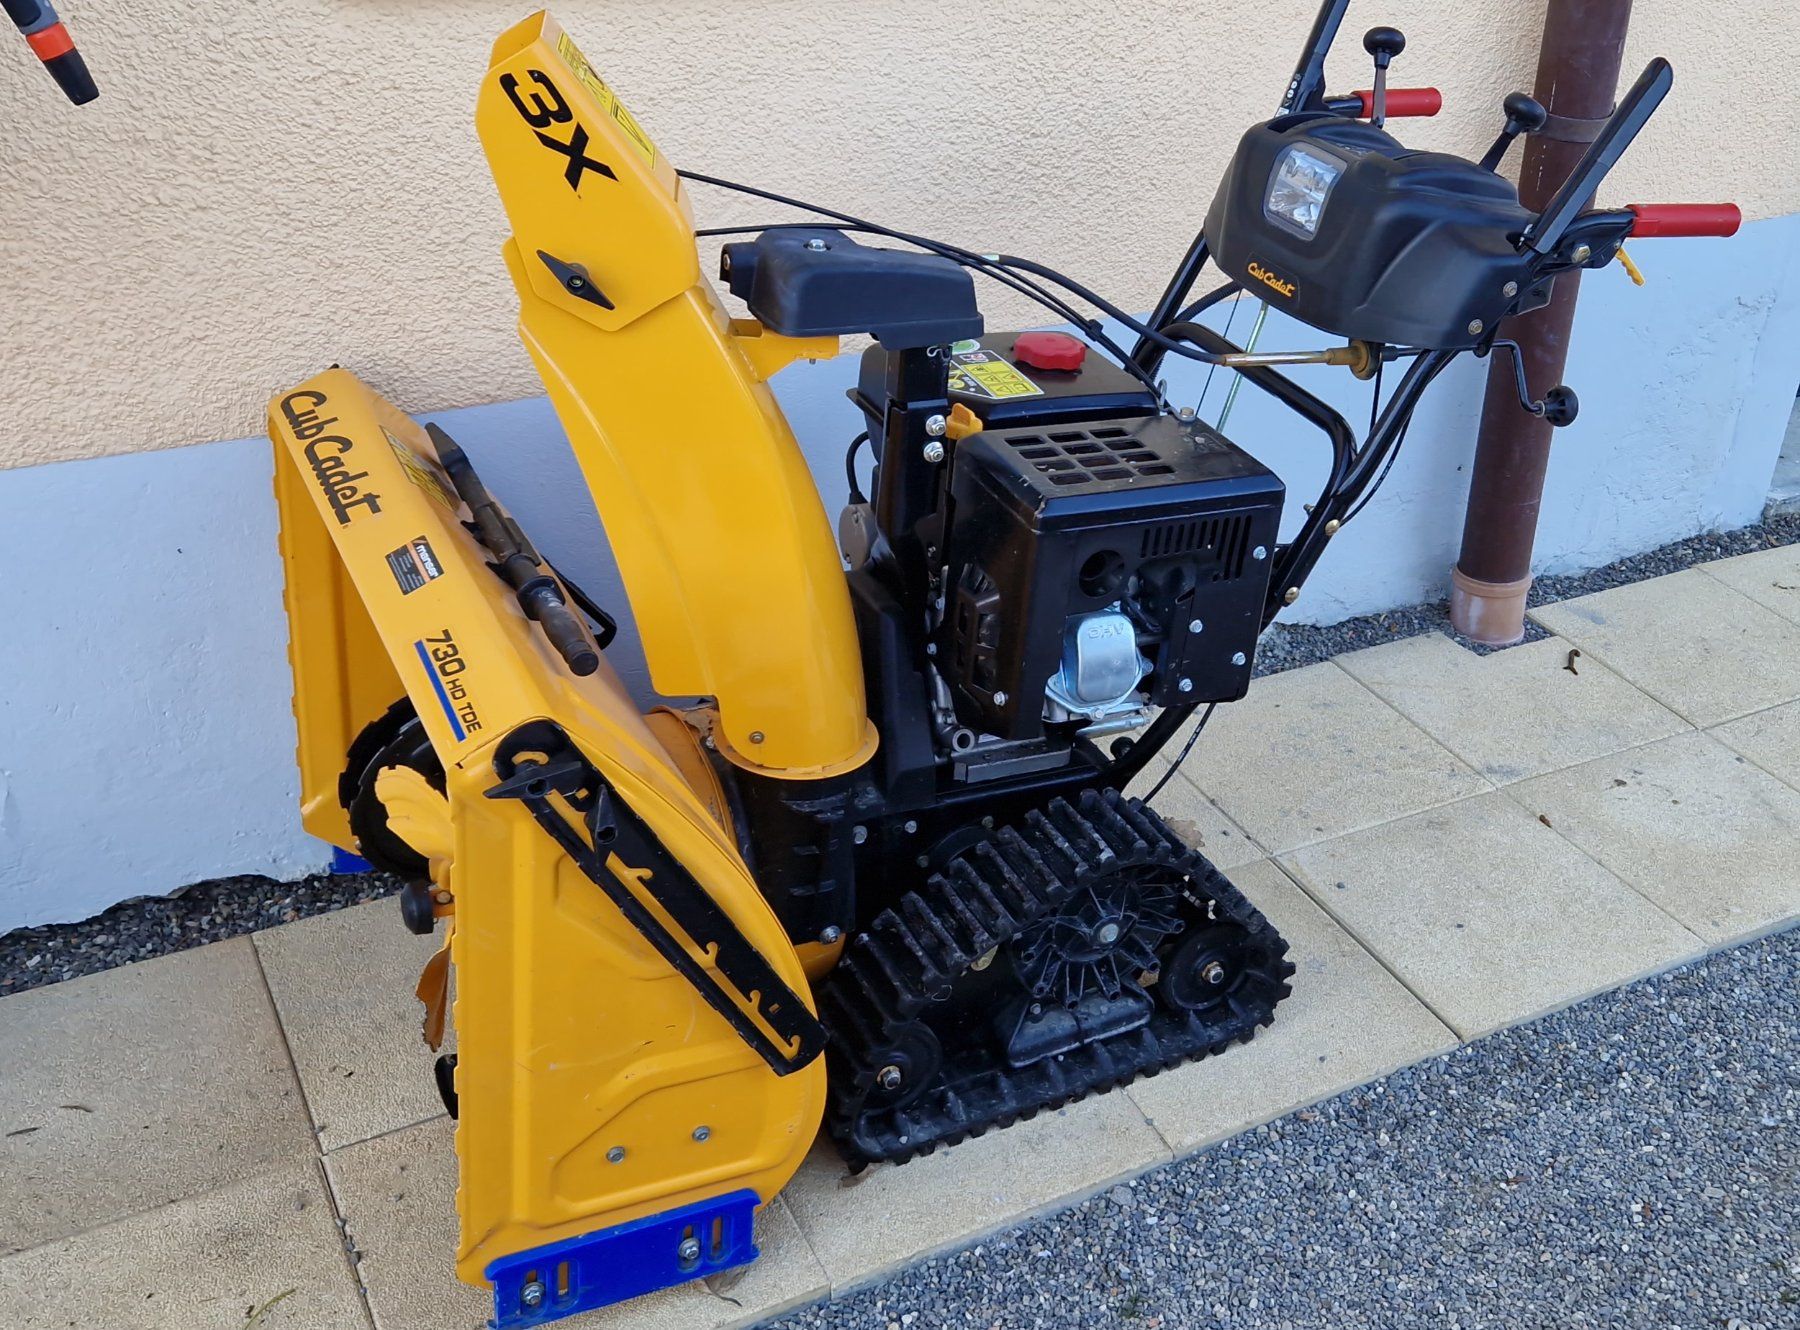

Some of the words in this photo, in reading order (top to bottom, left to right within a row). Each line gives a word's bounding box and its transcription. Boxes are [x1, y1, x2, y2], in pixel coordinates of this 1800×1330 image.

[499, 69, 619, 192] 3X
[1247, 262, 1265, 280] Cub
[1263, 272, 1296, 297] Cadet
[280, 390, 339, 440] Cub
[304, 435, 382, 526] Cadet
[1088, 622, 1125, 640] OHV
[425, 628, 466, 678] 730
[445, 678, 467, 701] HD
[458, 701, 483, 734] TDE
